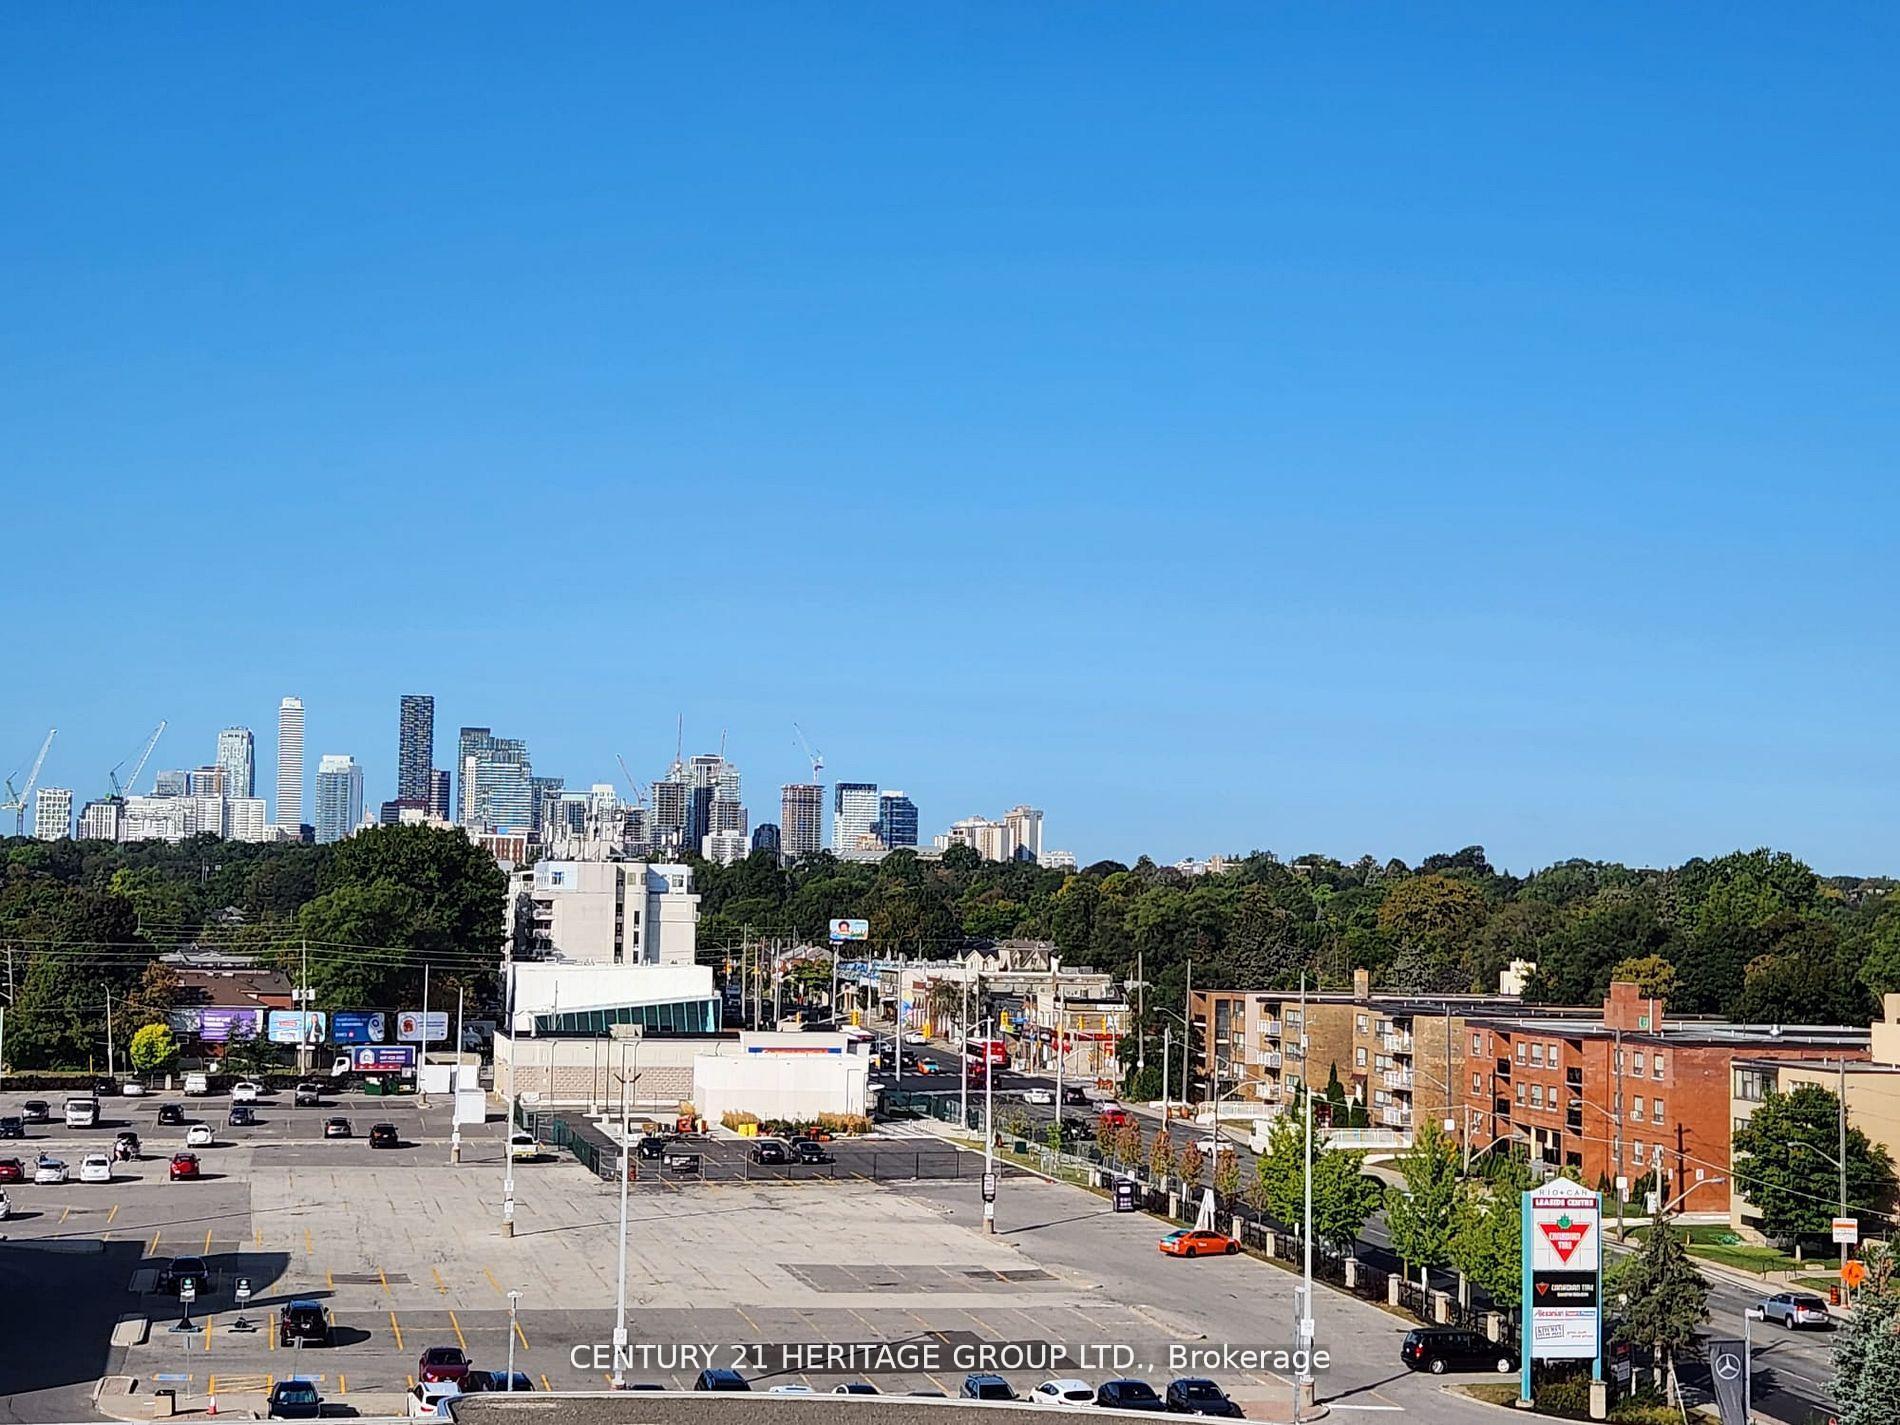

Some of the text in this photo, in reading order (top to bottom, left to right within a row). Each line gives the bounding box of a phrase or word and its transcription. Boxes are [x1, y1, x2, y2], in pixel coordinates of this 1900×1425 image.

[1535, 1198, 1594, 1207] LEASIDE CENTRE
[1548, 1232, 1581, 1241] CANADIAN
[1557, 1241, 1573, 1250] TIRE
[1550, 1283, 1594, 1292] CANADIAN TIRE
